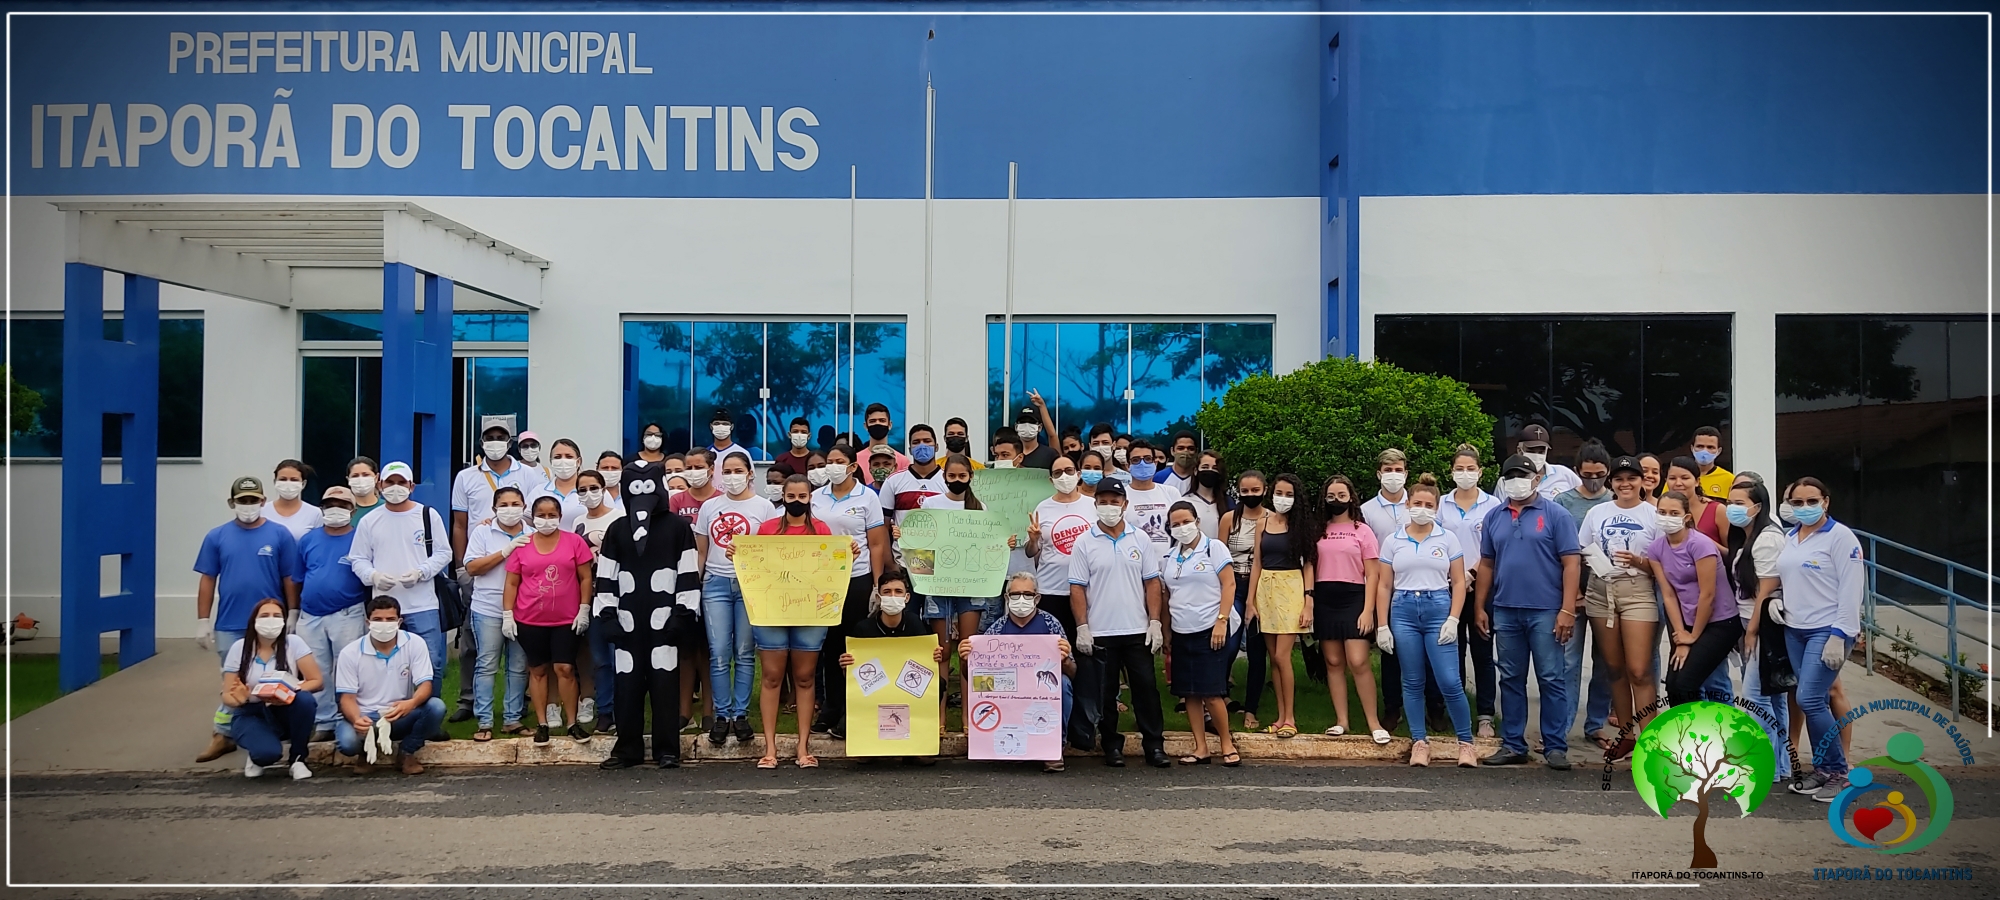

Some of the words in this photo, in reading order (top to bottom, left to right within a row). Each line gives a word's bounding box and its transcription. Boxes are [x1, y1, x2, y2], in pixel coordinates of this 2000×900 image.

[169, 30, 420, 74] PREFEITURA
[440, 31, 653, 74] MUNICIPAL
[31, 87, 301, 169] ITAPORÃ
[330, 103, 420, 169] DO
[448, 104, 820, 171] TOCANTINS
[902, 520, 936, 529] CONTRA
[1053, 524, 1090, 541] DENGUE
[987, 639, 1024, 653] Dengue
[972, 651, 997, 662] Dengue
[907, 660, 932, 677] DENGUE
